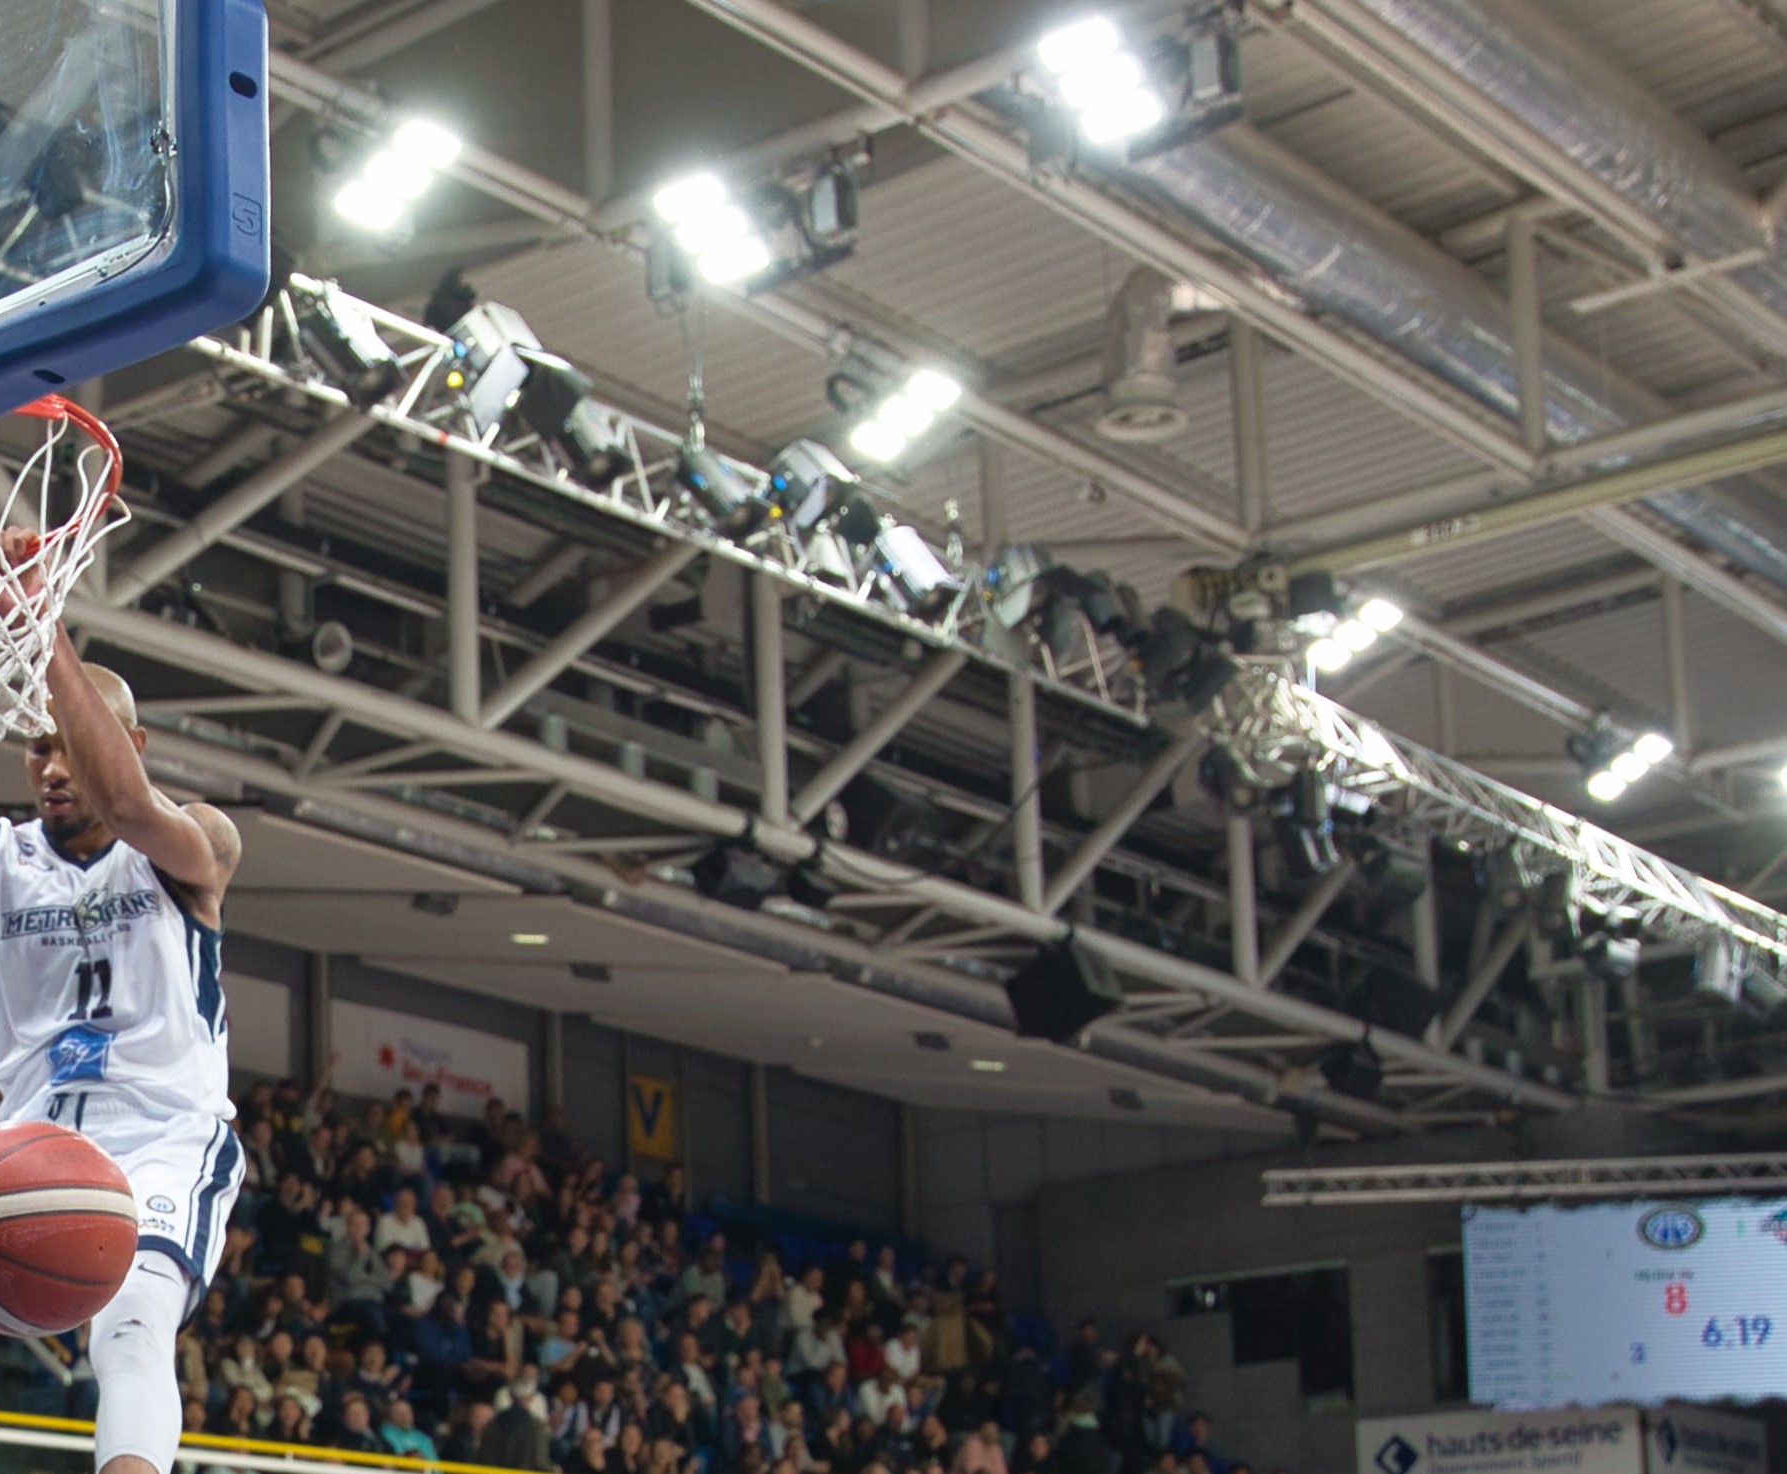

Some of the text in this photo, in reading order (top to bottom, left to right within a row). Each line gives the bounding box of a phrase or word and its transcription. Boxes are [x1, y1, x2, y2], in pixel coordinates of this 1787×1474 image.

[68, 958, 114, 1021] 11
[631, 1085, 663, 1136] V
[1665, 1281, 1688, 1318] 8
